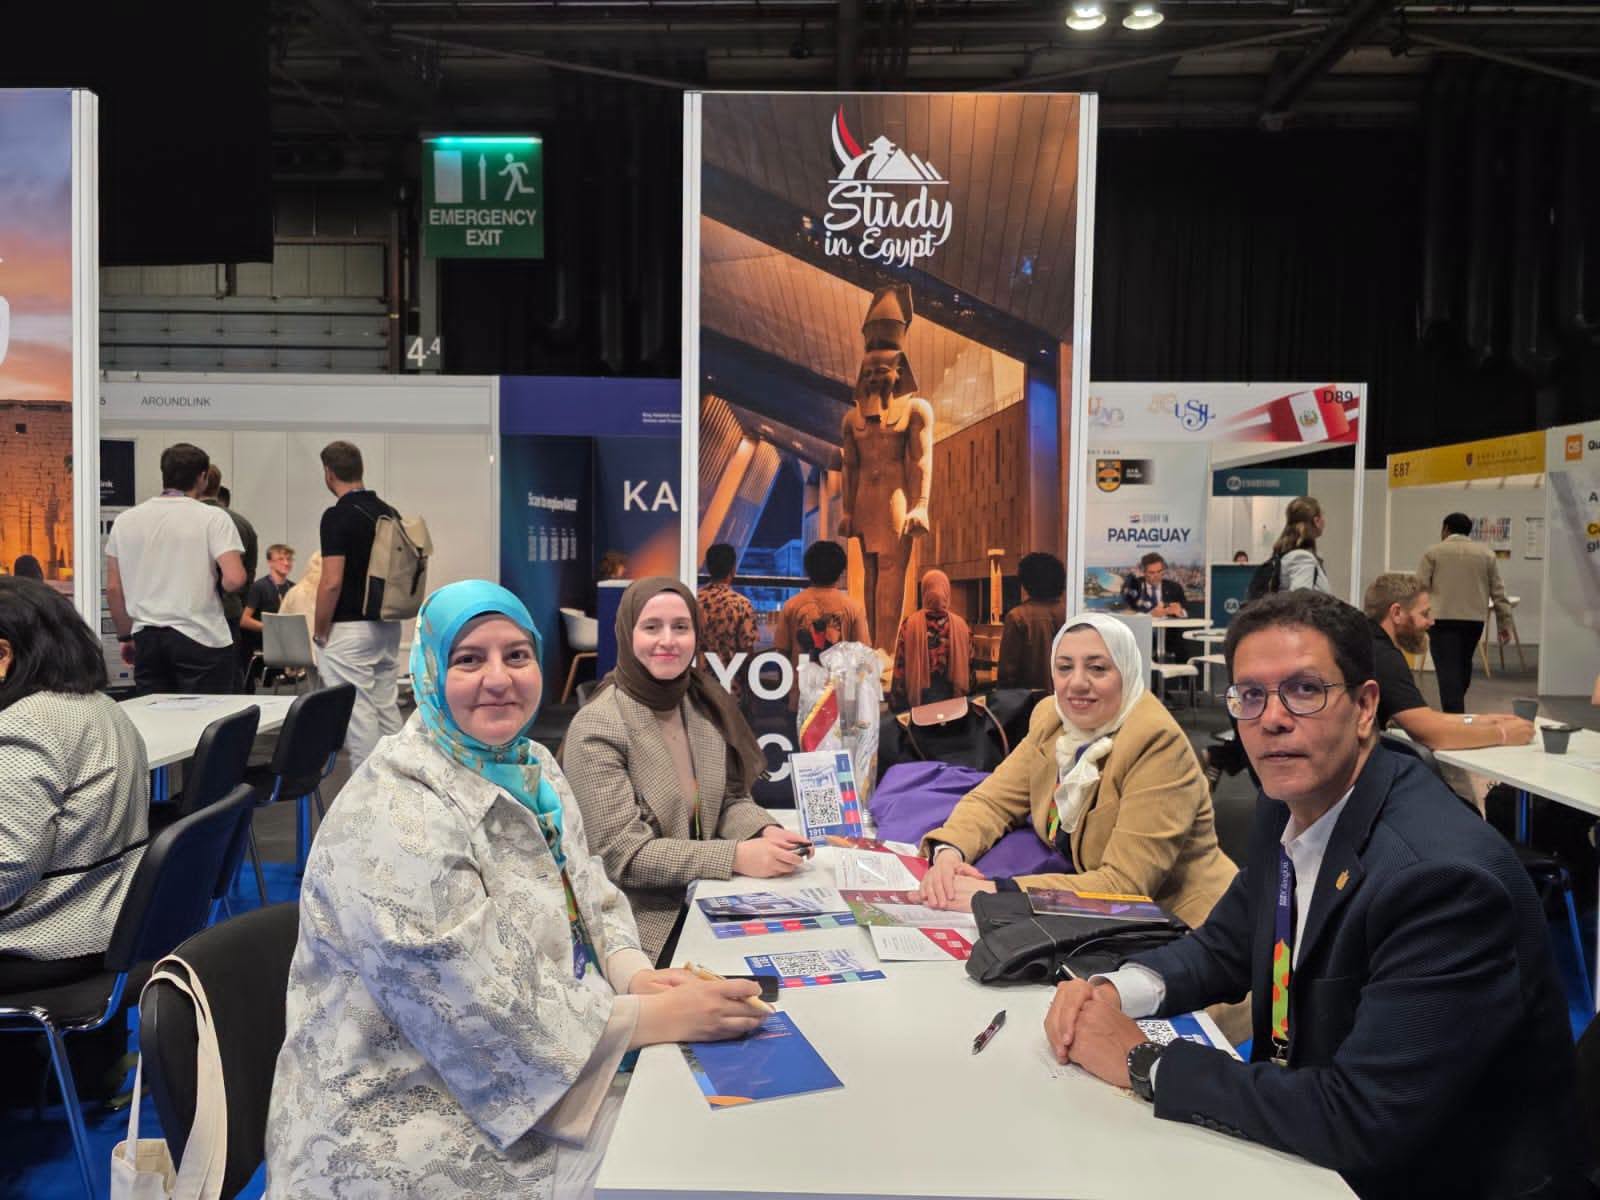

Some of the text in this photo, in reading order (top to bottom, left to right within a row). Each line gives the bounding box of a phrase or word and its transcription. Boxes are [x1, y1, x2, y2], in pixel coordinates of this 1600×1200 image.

[429, 209, 537, 225] EMERGENCY
[824, 183, 953, 246] Study
[466, 229, 503, 246] EXIT
[825, 227, 936, 268] in Egypt
[141, 397, 212, 407] AROUNDLINK
[1323, 390, 1353, 404] D89
[1393, 462, 1411, 478] E87
[623, 480, 680, 512] KA
[1107, 528, 1191, 542] PARAGUAY
